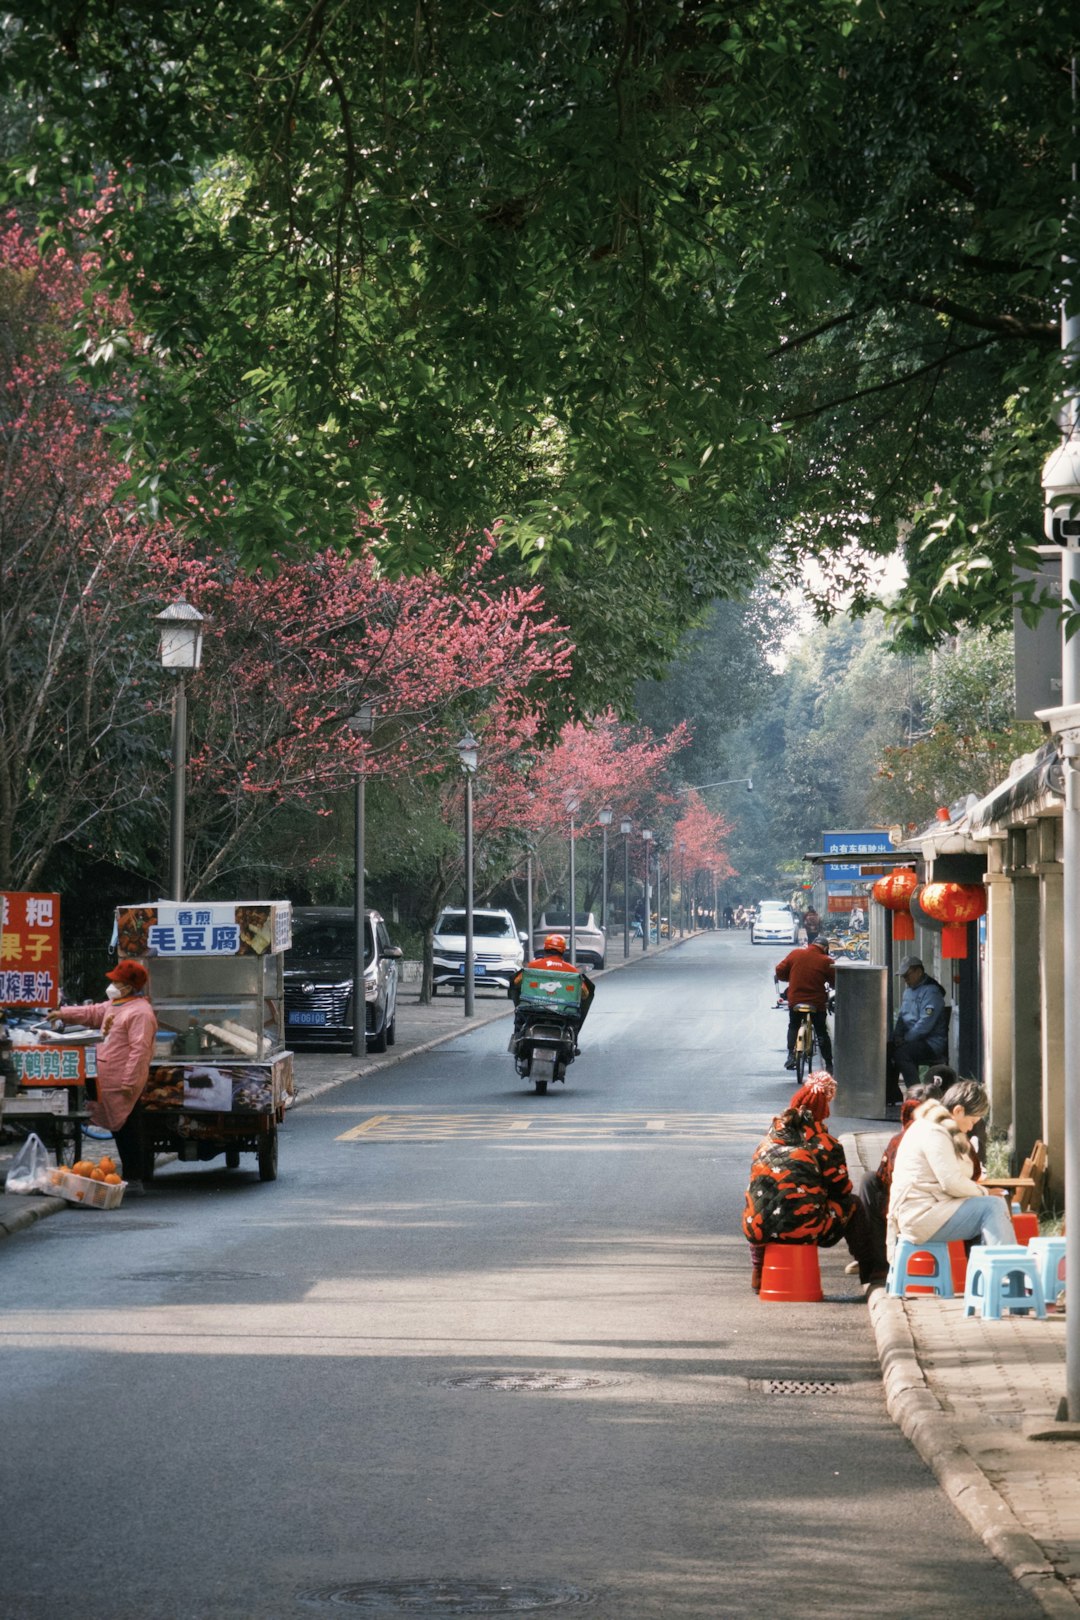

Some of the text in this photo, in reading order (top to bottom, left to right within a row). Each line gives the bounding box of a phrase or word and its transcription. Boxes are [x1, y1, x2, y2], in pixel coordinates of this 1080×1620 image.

[178, 911, 211, 925] 香煎
[0, 933, 53, 961] 果子
[151, 926, 238, 951] 毛豆腐
